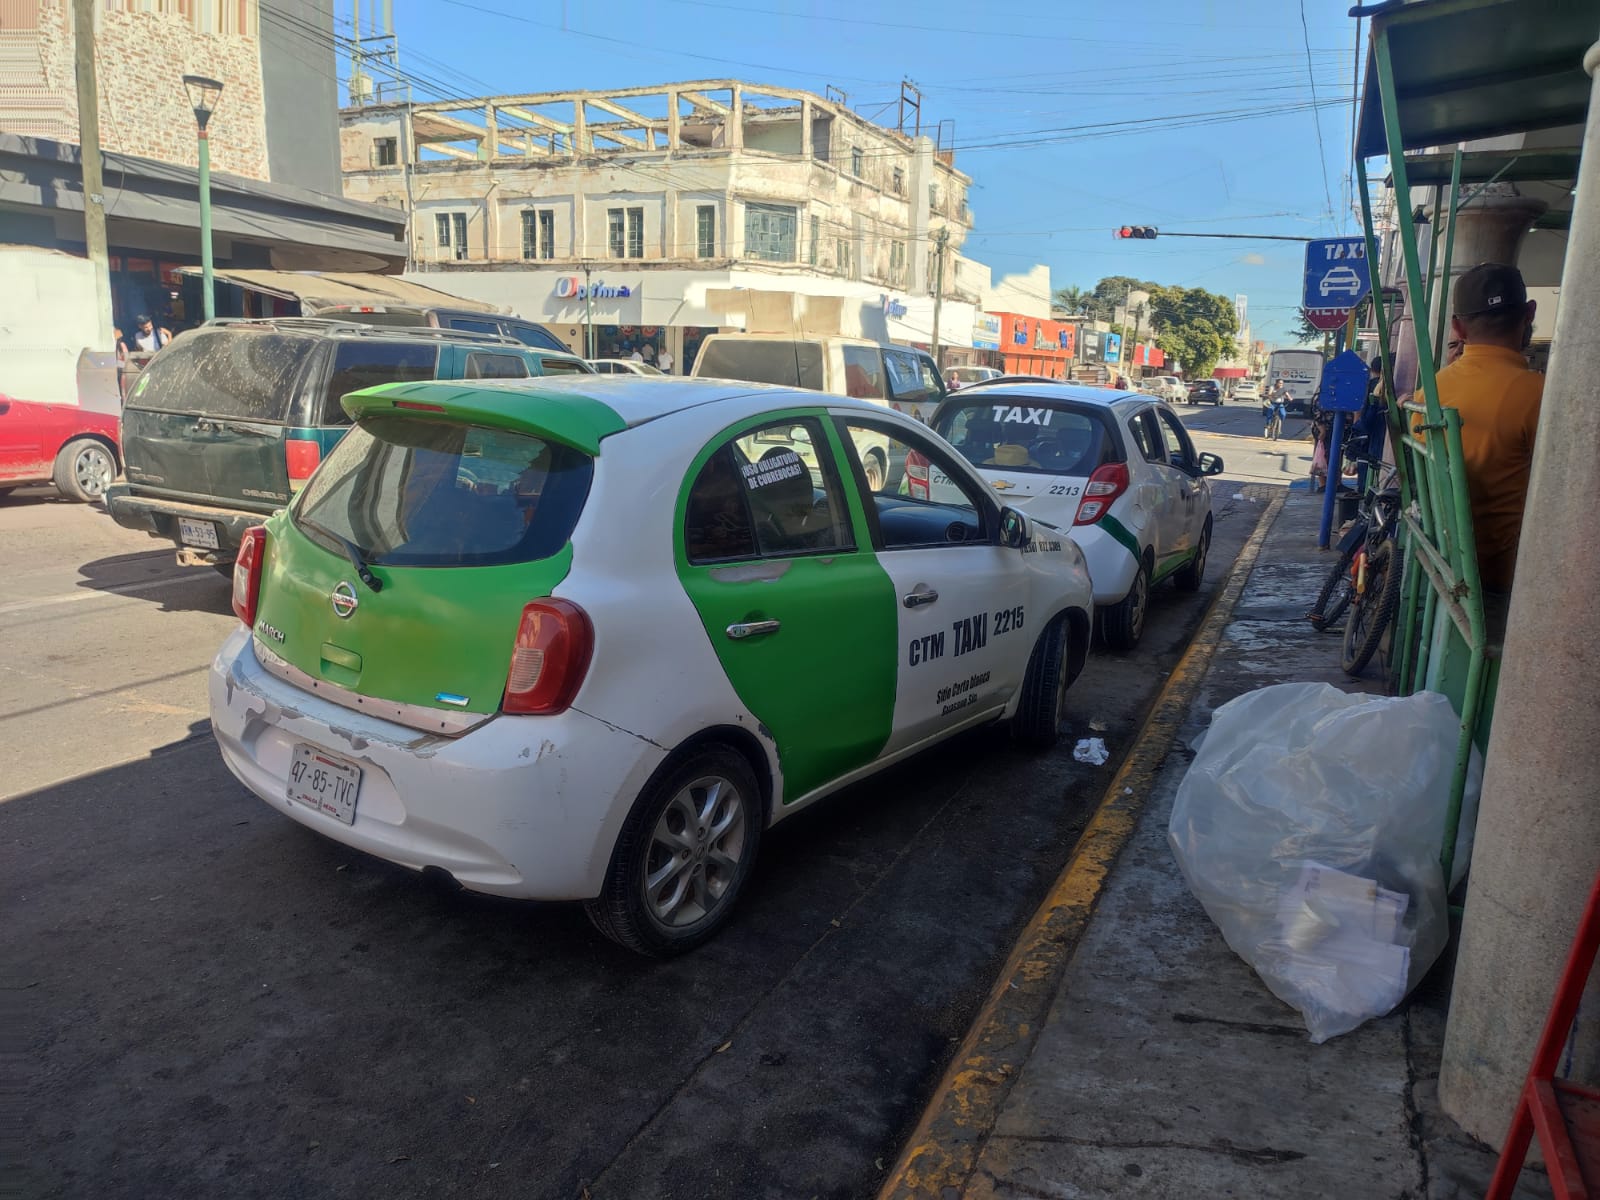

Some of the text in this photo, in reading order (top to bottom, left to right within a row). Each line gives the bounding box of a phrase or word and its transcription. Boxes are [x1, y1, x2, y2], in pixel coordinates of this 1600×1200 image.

[1324, 243, 1365, 260] TAXI
[992, 405, 1053, 426] TAXI
[758, 452, 799, 473] OBLIGATORIO
[747, 476, 760, 490] DE
[1049, 485, 1080, 497] 2213
[908, 605, 1024, 667] CTM TAXI 2215
[291, 760, 355, 807] 47-85-TVC
